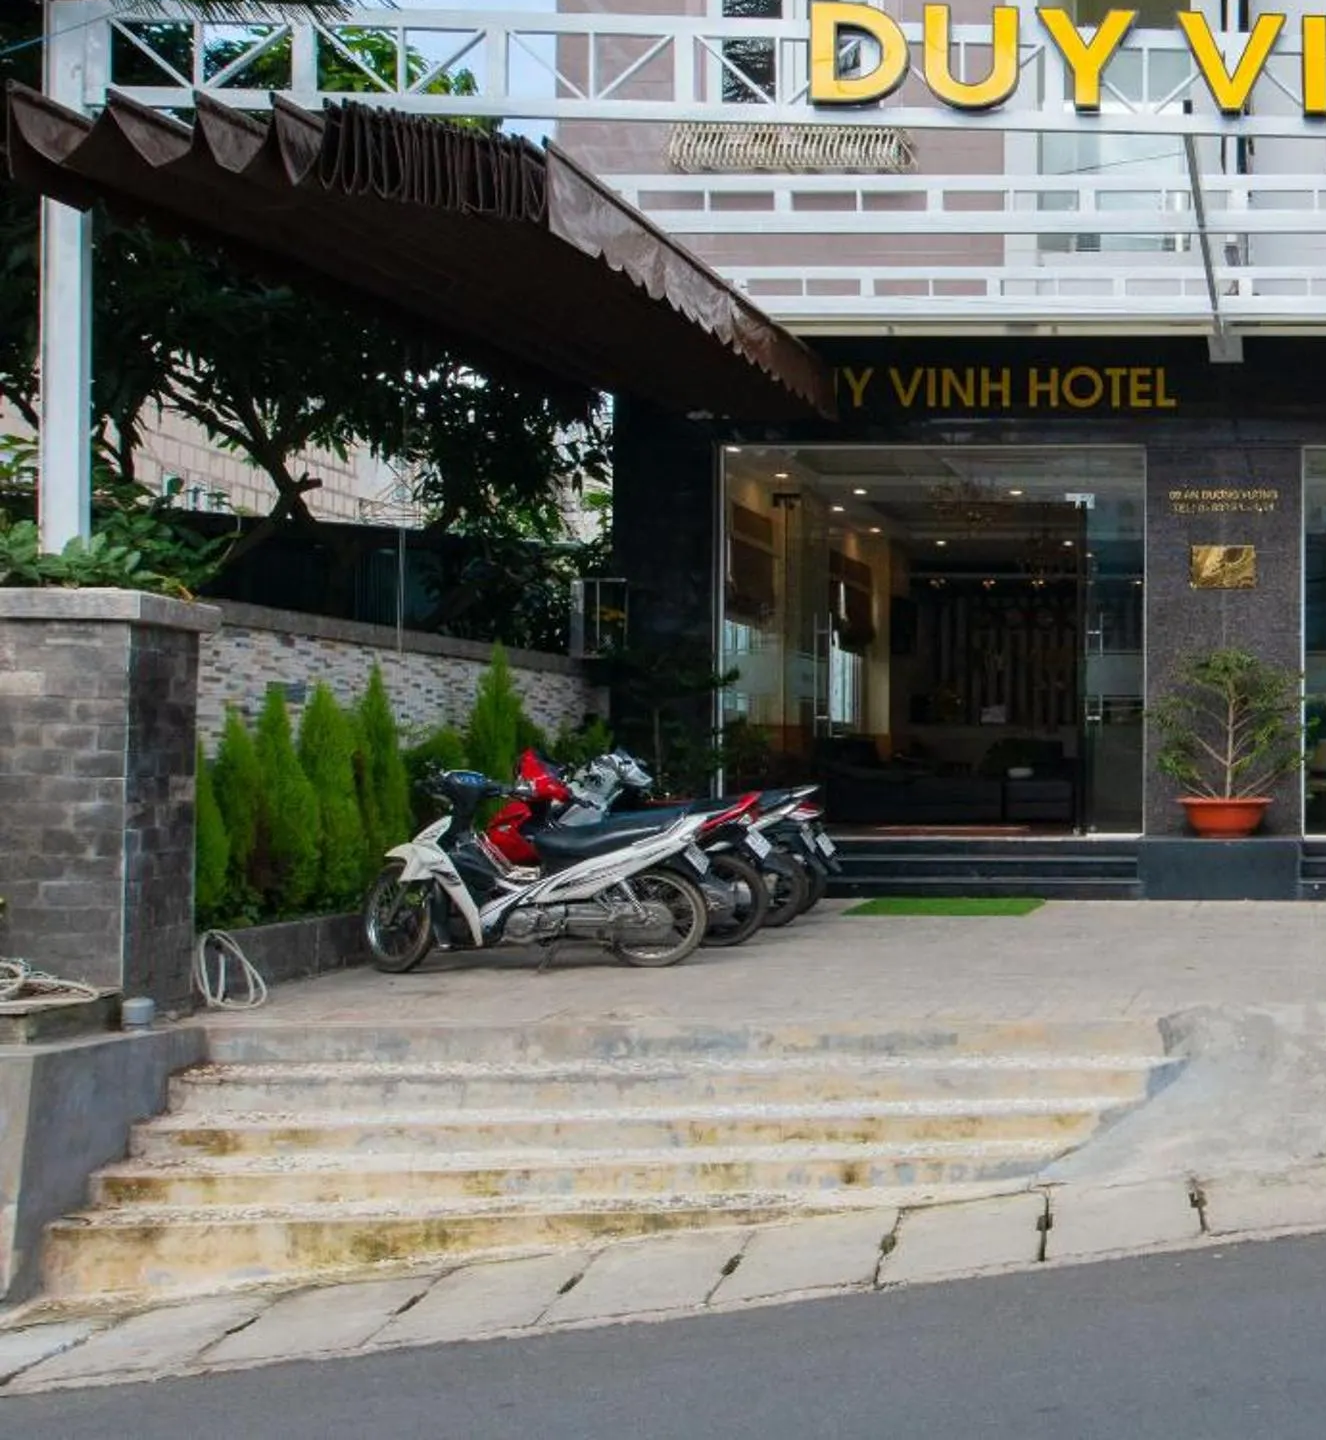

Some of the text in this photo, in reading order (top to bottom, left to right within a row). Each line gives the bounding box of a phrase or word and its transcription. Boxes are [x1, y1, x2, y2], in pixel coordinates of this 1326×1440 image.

[807, 2, 1138, 114] DUY
[890, 367, 1010, 408] VINH
[1029, 367, 1178, 408] HOTEL
